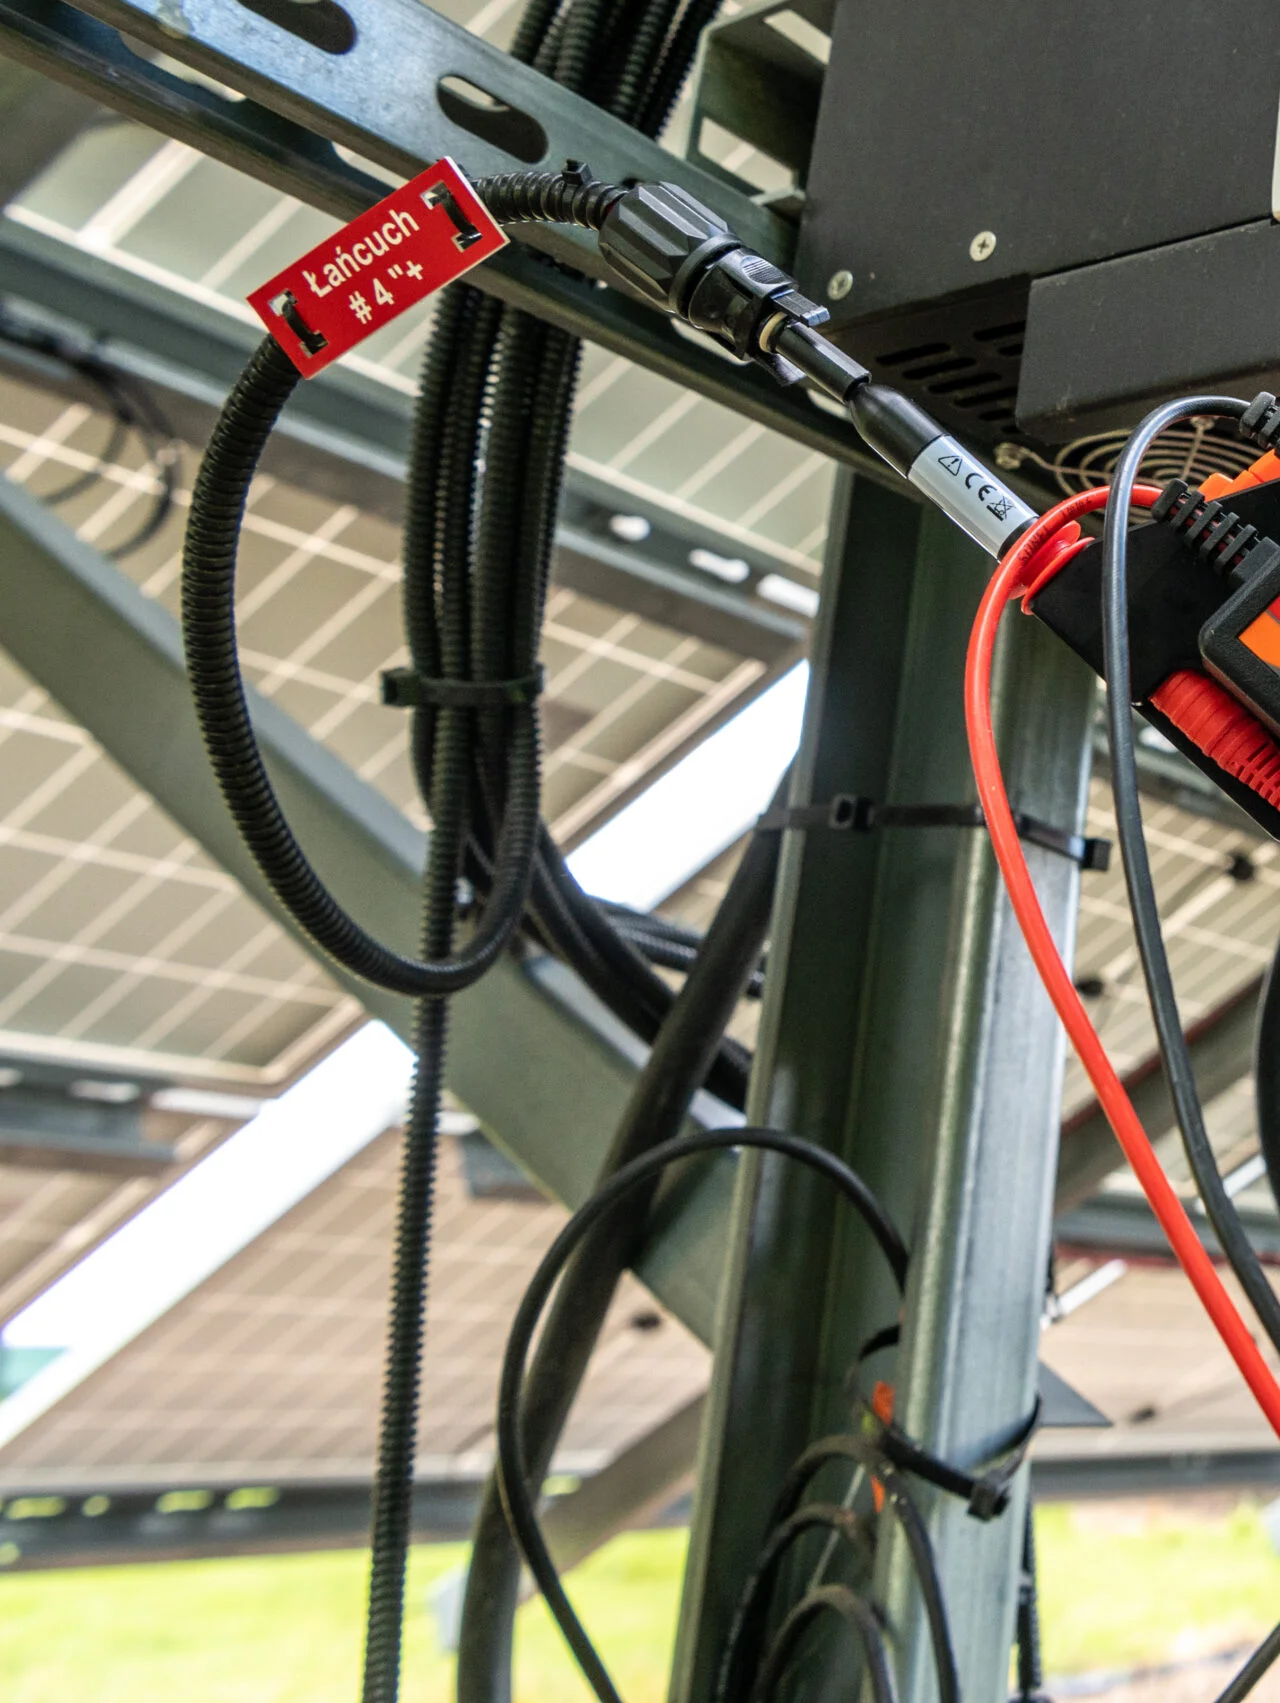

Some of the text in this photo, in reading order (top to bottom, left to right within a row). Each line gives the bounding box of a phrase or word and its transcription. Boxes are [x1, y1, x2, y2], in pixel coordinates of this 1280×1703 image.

[301, 209, 420, 298] Łańcuch
[349, 290, 373, 325] #
[373, 277, 395, 307] 4
